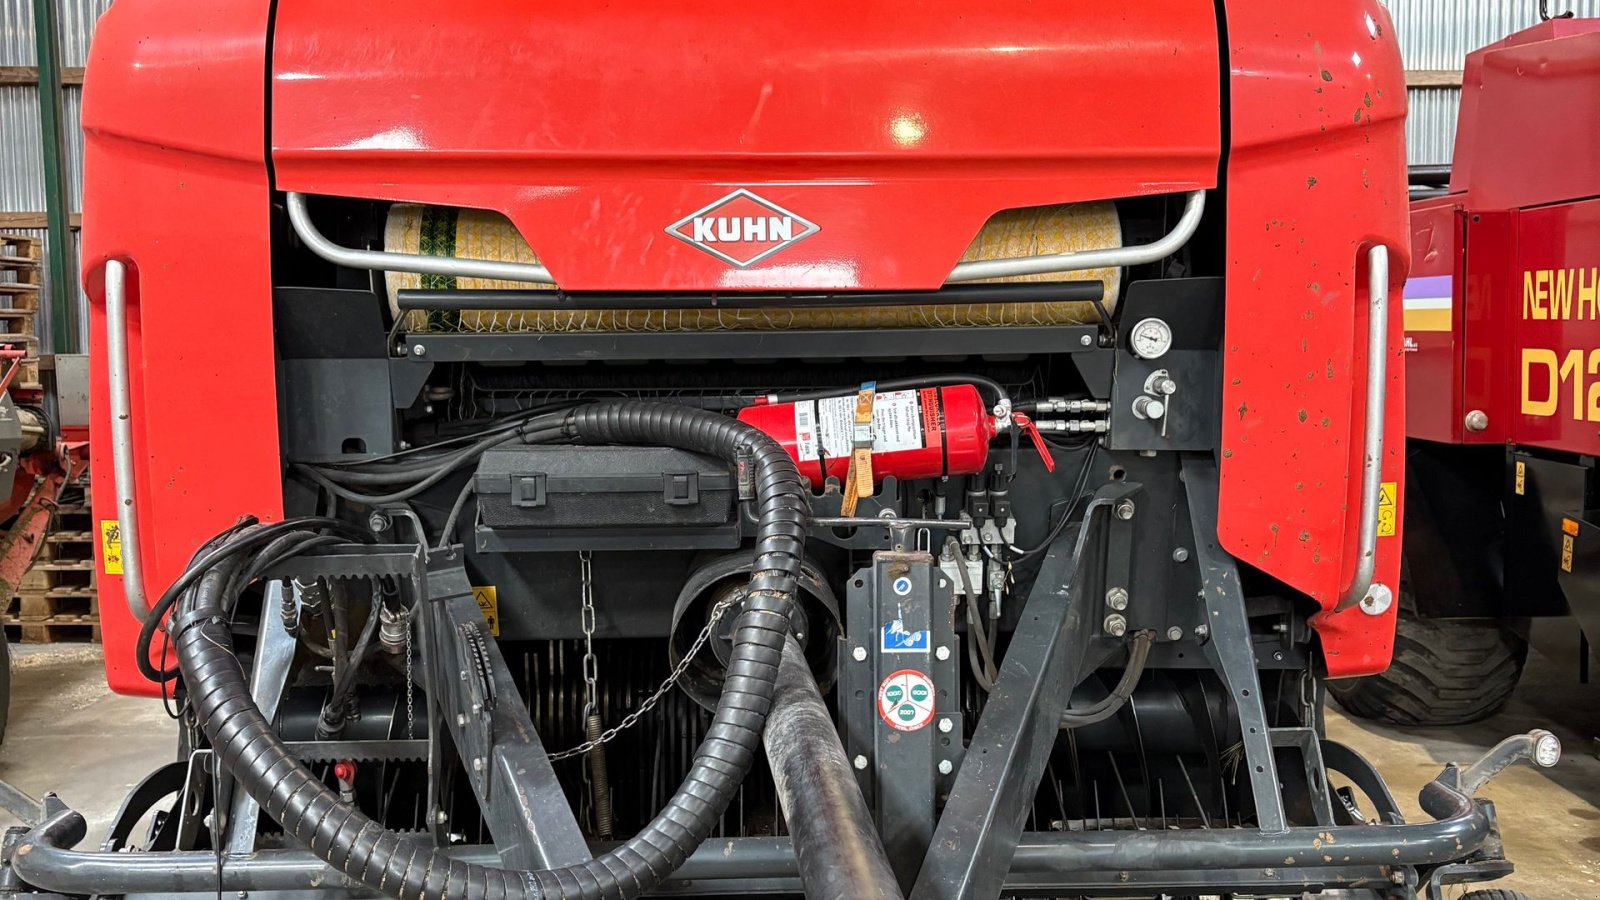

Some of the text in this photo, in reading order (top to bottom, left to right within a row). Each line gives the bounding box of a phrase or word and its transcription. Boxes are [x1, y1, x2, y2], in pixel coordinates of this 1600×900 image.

[694, 217, 792, 242] KUHN
[1523, 269, 1574, 320] NEW
[1577, 267, 1600, 320] H
